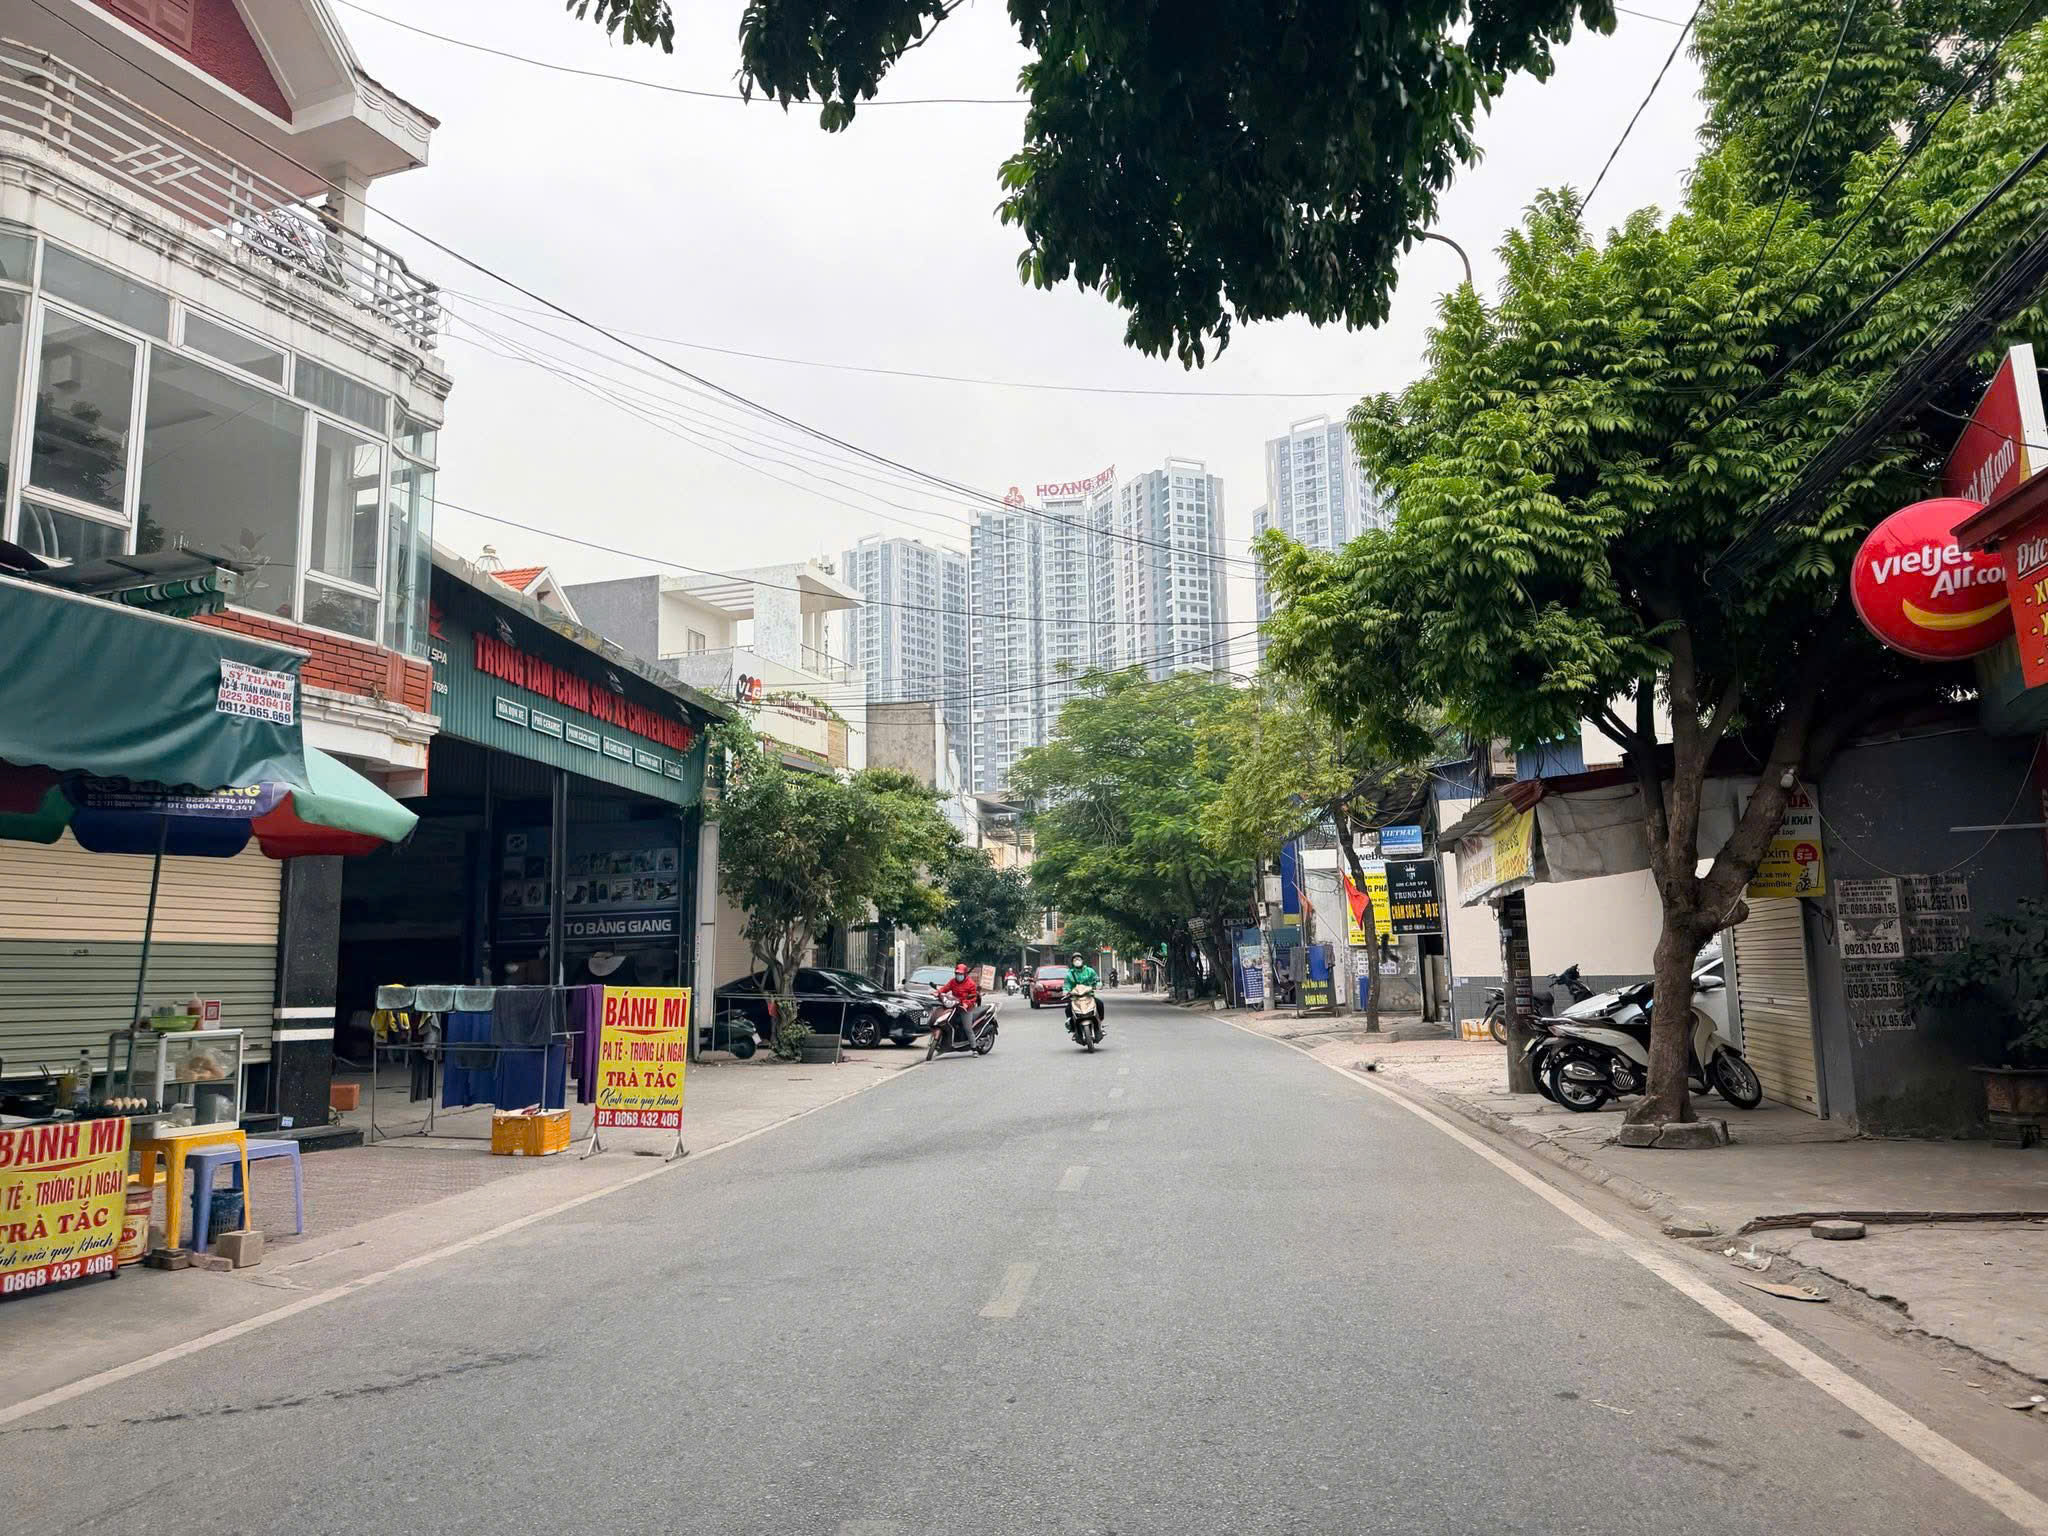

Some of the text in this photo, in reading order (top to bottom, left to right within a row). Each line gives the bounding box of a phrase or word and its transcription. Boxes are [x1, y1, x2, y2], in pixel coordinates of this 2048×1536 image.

[1930, 565, 2006, 599] Air.co
[431, 647, 447, 665] SPA
[473, 631, 523, 686] TRUNG
[221, 677, 239, 691] 64
[738, 680, 761, 697] VLG
[218, 700, 291, 724] 0912.665.669
[1382, 828, 1418, 837] VIETMAP
[1394, 890, 1417, 899] TRUNG
[628, 918, 672, 933] GIANG
[1847, 982, 1904, 999] 0938.559.38
[605, 990, 687, 1028] BÁNH MÌ
[602, 1041, 612, 1061] PA
[605, 1064, 677, 1088] TRÀ TẮC
[614, 1111, 638, 1126] 0868
[640, 1112, 658, 1127] 432
[661, 1113, 679, 1127] 406
[7, 1179, 24, 1211] TÊ
[35, 1174, 74, 1207] TRỨNG
[78, 1169, 92, 1199] LÁ
[57, 1200, 109, 1235] TẮC
[3, 1254, 114, 1293] 0868 432 406
